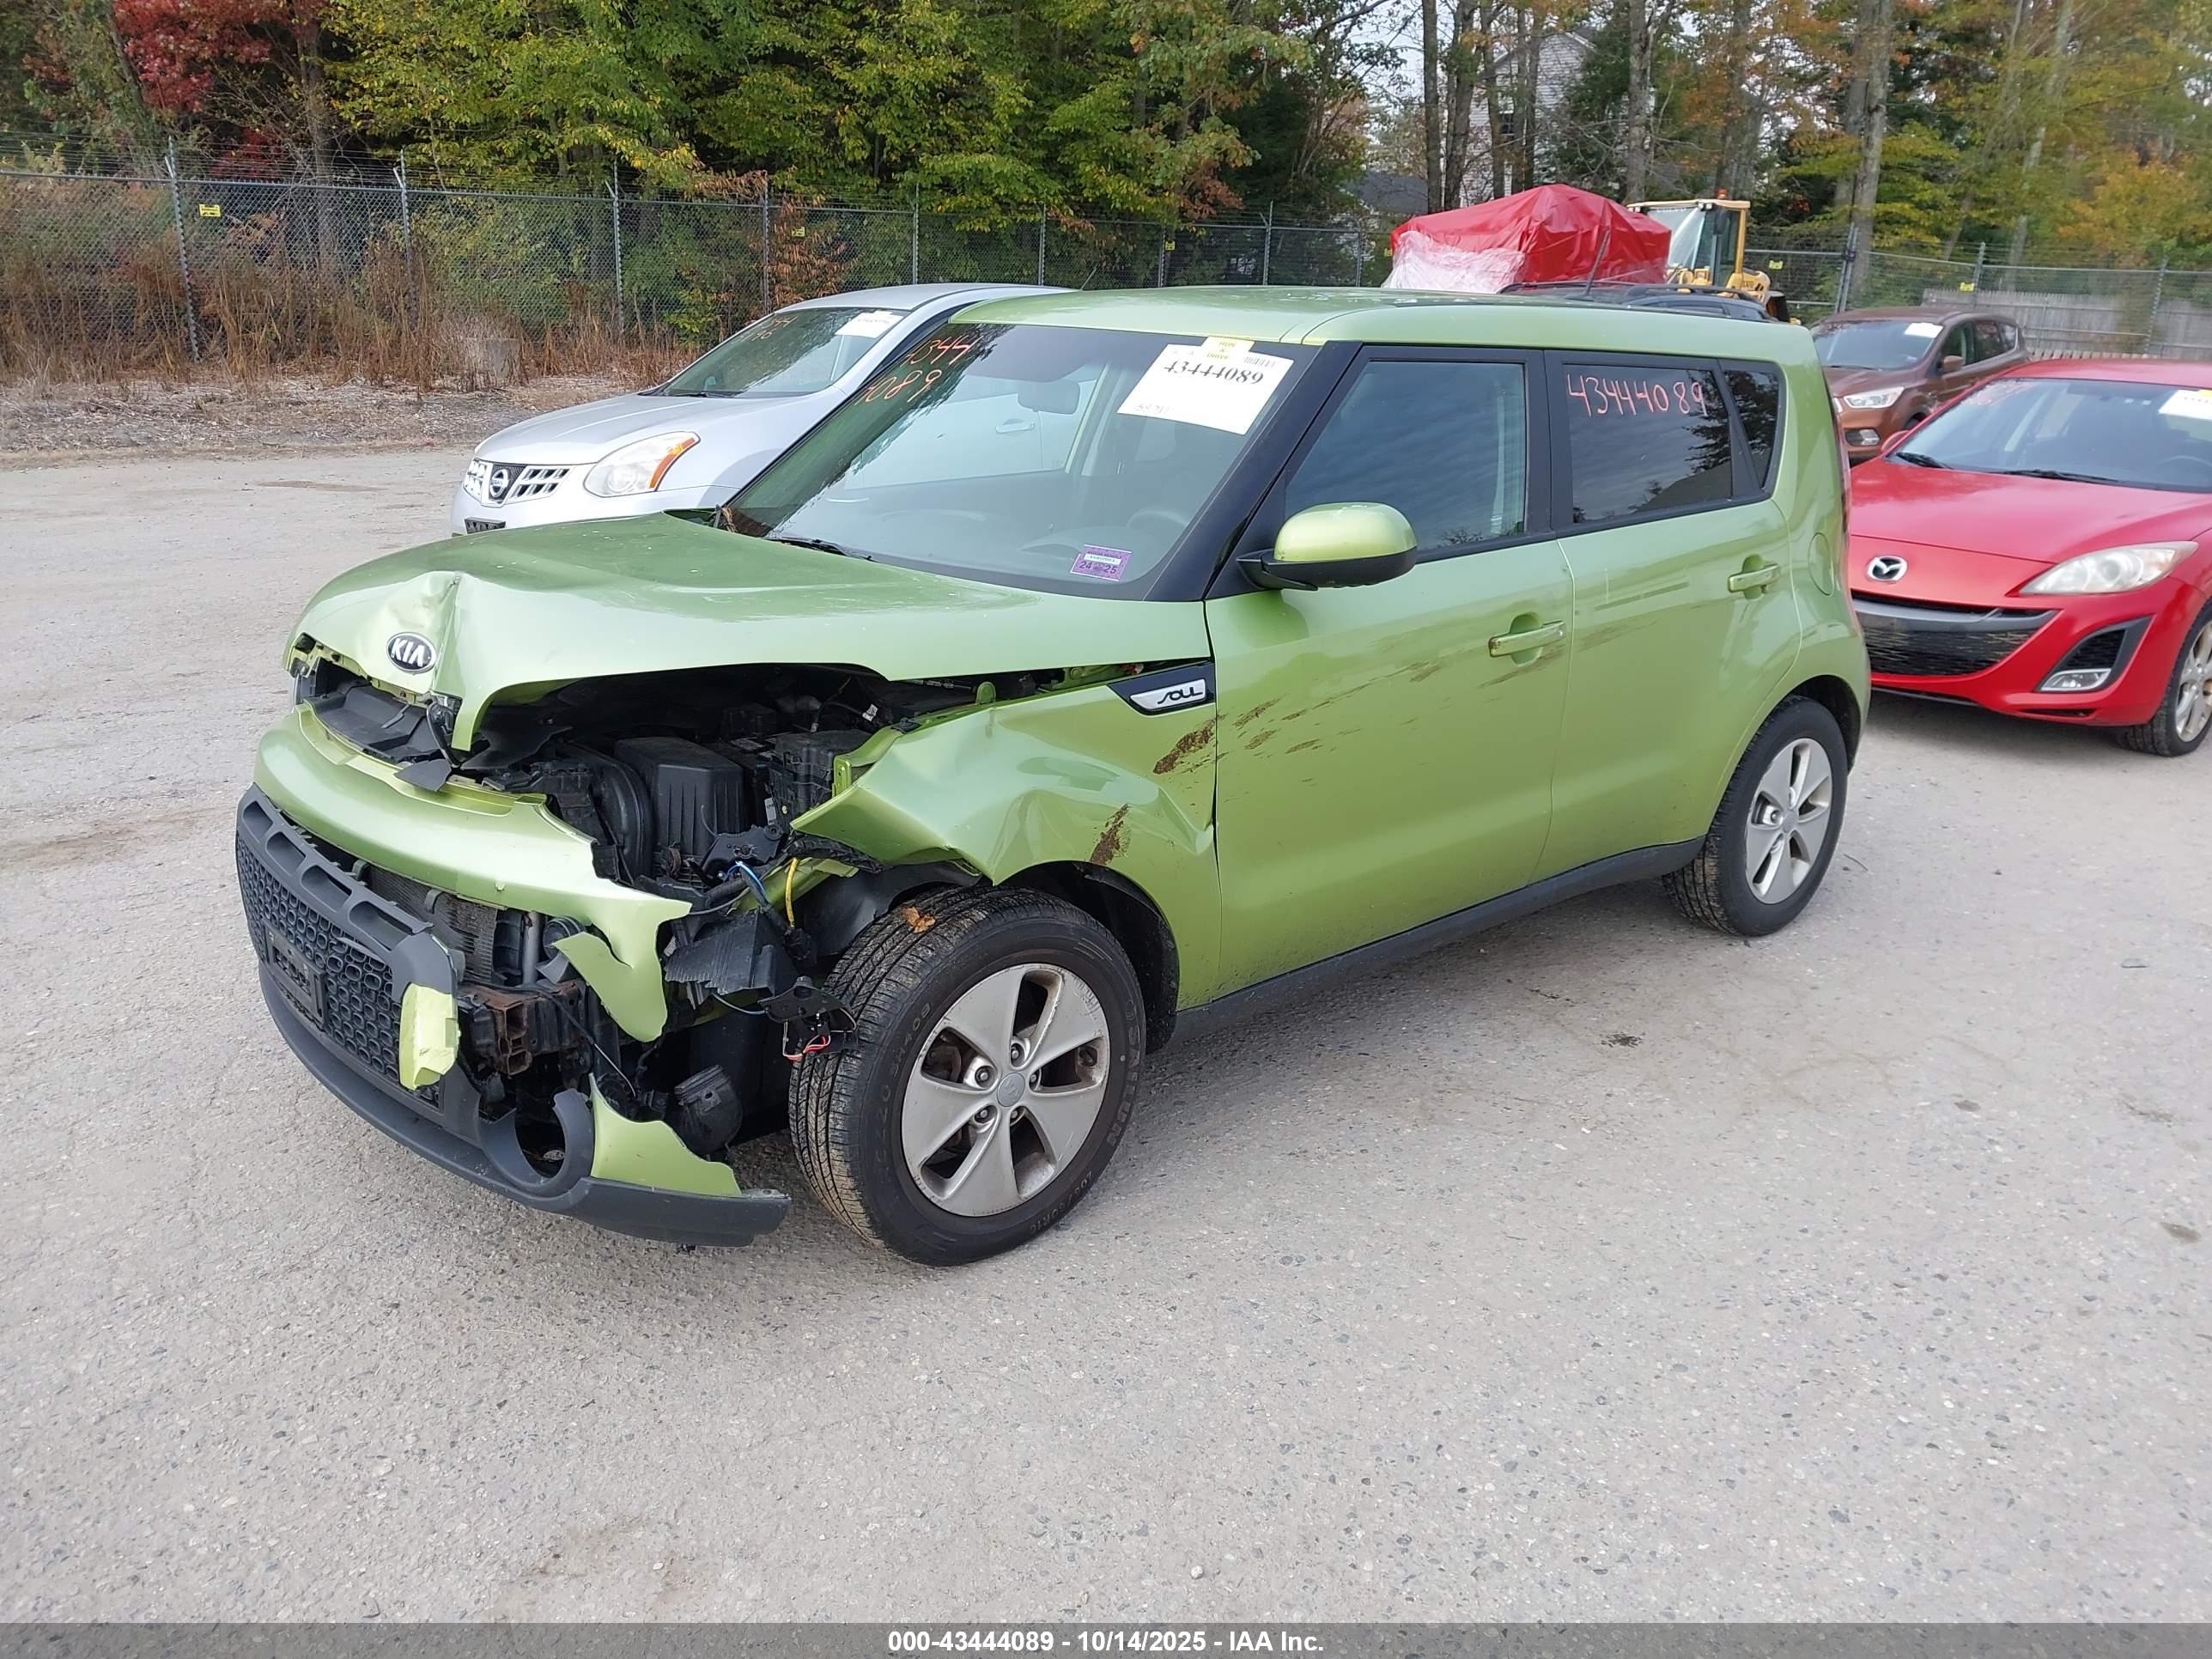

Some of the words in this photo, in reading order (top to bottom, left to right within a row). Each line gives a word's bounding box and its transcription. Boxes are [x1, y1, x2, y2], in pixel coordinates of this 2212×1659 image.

[1164, 360, 1264, 385] 43444089
[1567, 374, 1708, 417] 43444089
[1079, 561, 1093, 569] 24
[1104, 564, 1117, 574] 25
[391, 637, 425, 667] KIA
